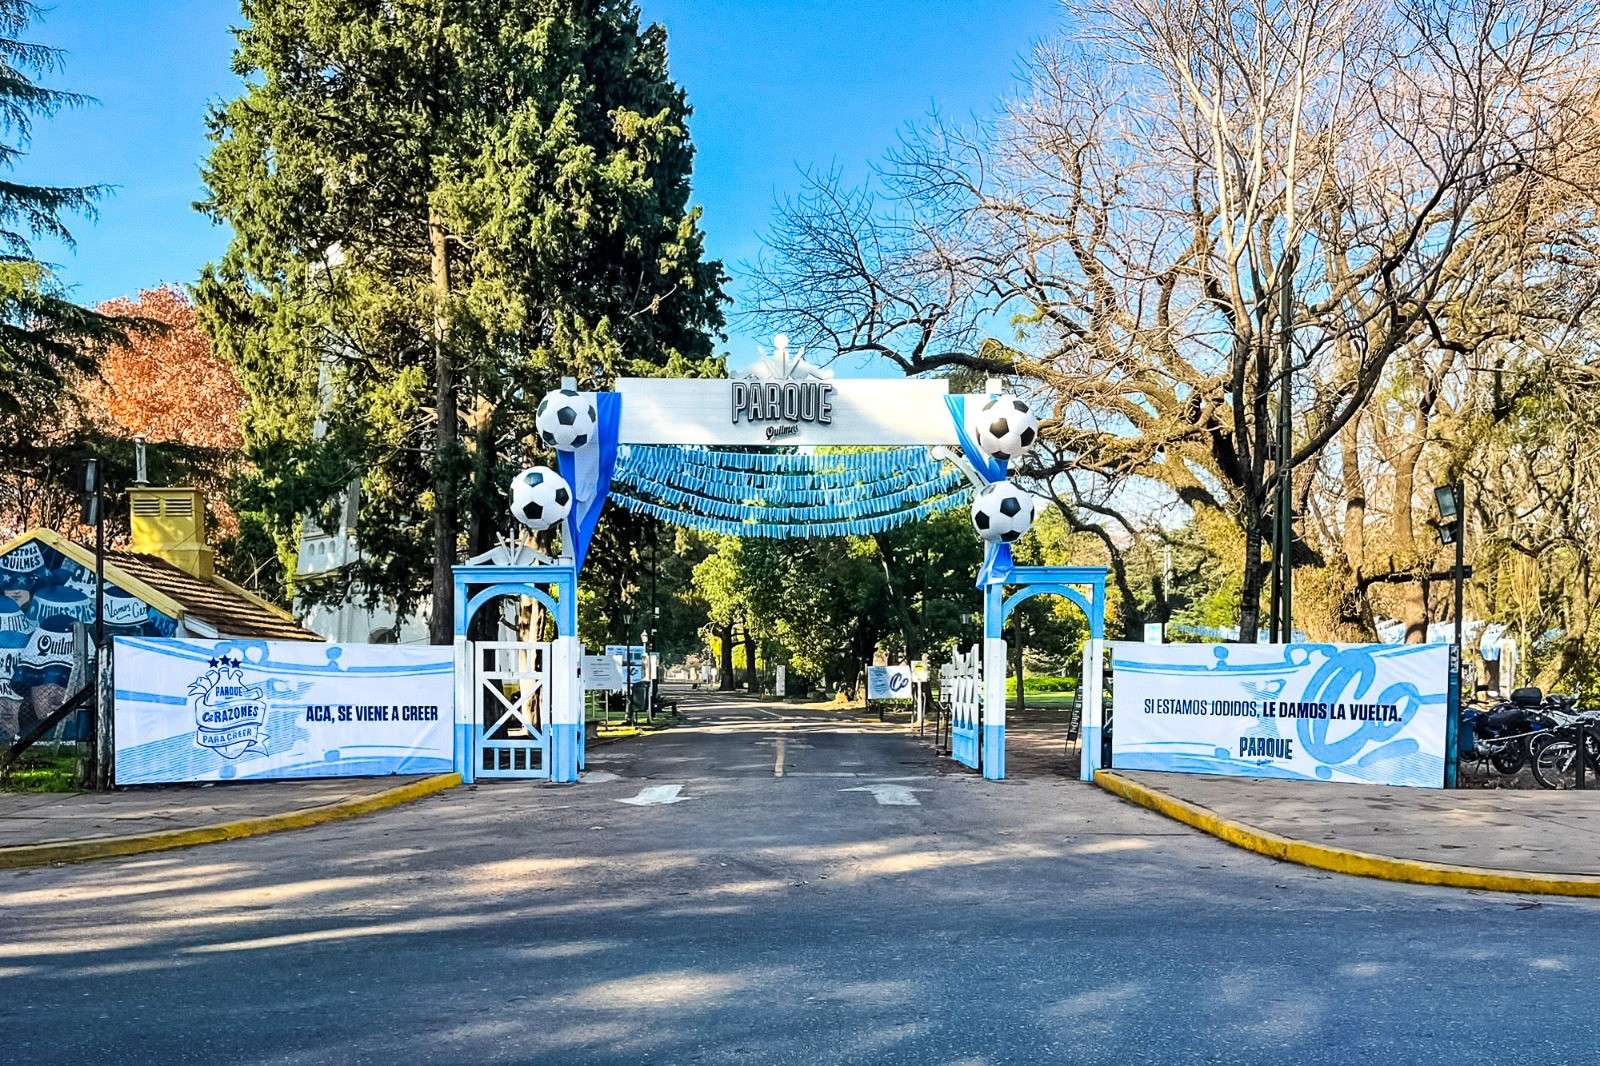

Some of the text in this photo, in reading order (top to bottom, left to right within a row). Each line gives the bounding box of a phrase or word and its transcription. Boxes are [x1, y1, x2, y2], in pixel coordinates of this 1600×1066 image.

[732, 382, 833, 425] PARQUE
[3, 556, 41, 571] QUILMES
[216, 686, 243, 697] PARQUE
[306, 705, 438, 724] ACA, SE VIENE A CREER
[1144, 699, 1402, 722] SI ESTAMOS JODIDOS, LE DAMOS LA VUELTA.
[203, 729, 252, 744] PARA CREER
[1240, 736, 1293, 760] PARQUE
